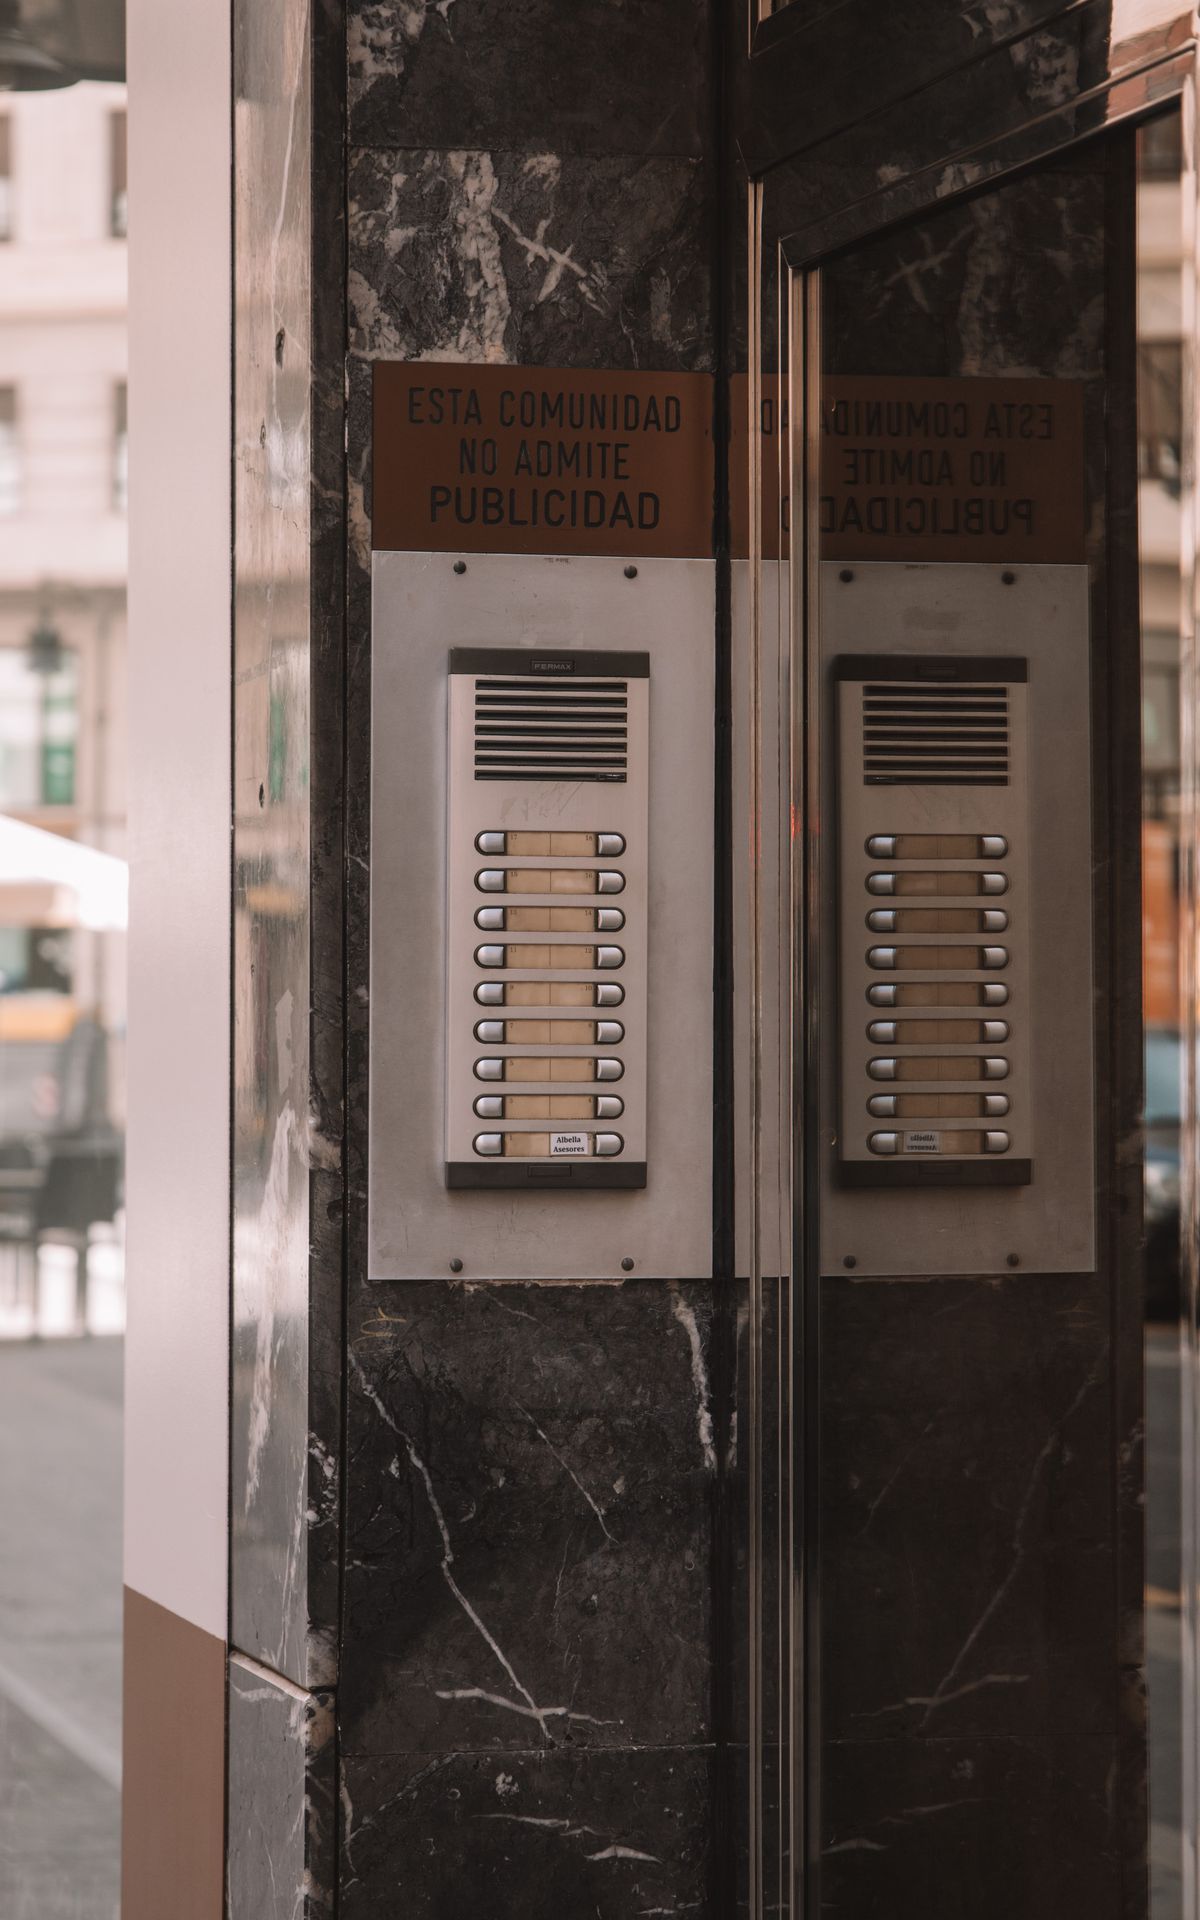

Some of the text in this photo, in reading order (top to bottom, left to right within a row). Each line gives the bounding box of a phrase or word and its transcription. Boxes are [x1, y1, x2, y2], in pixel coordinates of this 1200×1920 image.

[408, 387, 682, 433] ESTA COMUNIDAD
[459, 438, 631, 480] NO ADMITE
[430, 485, 660, 530] PUBLICIDAD
[534, 663, 572, 671] FERMAX
[556, 1136, 581, 1144] Albella
